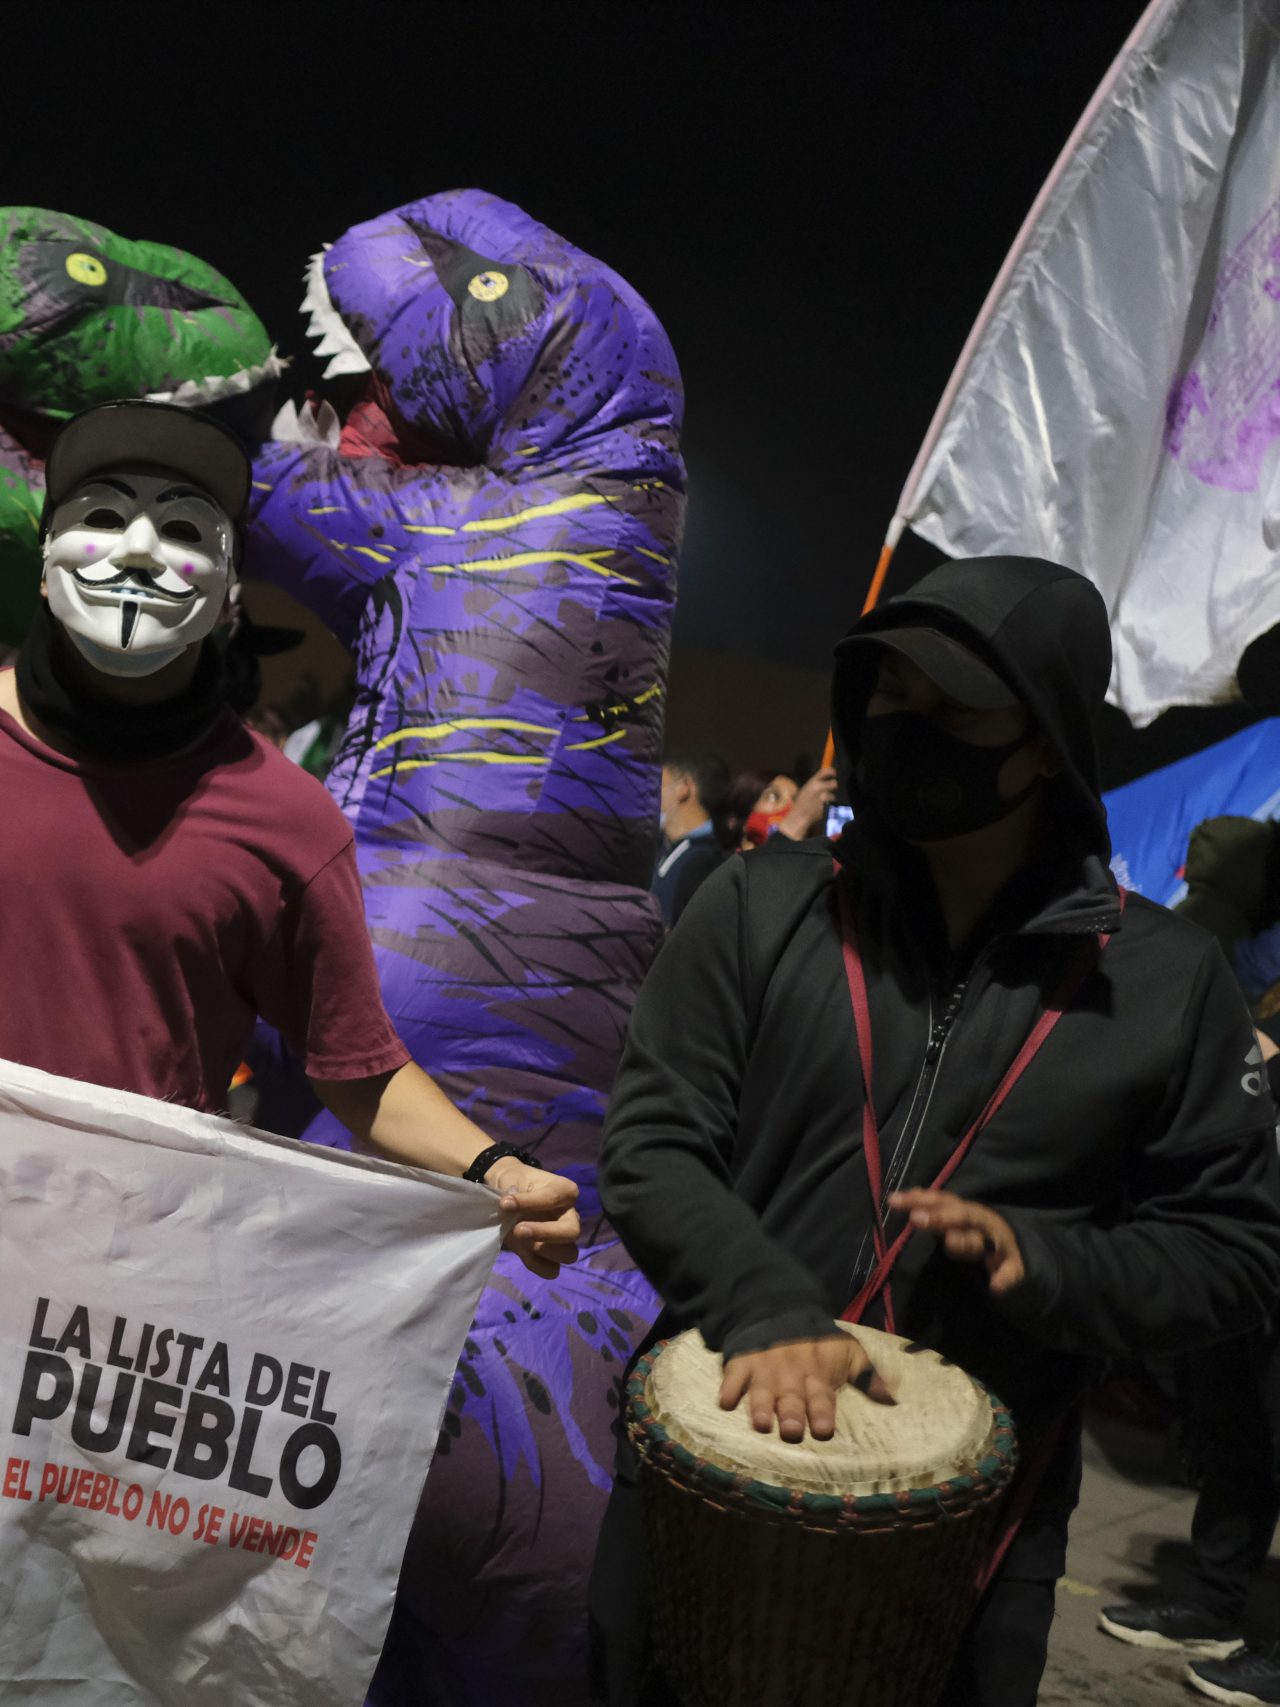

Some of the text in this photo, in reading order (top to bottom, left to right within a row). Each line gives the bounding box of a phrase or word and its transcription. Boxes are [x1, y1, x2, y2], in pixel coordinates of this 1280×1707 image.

[28, 1297, 337, 1425] LA LISTA DEL
[12, 1350, 342, 1510] PUEBLO
[1, 1457, 318, 1569] EL PUEBLO NO SE VENDE
